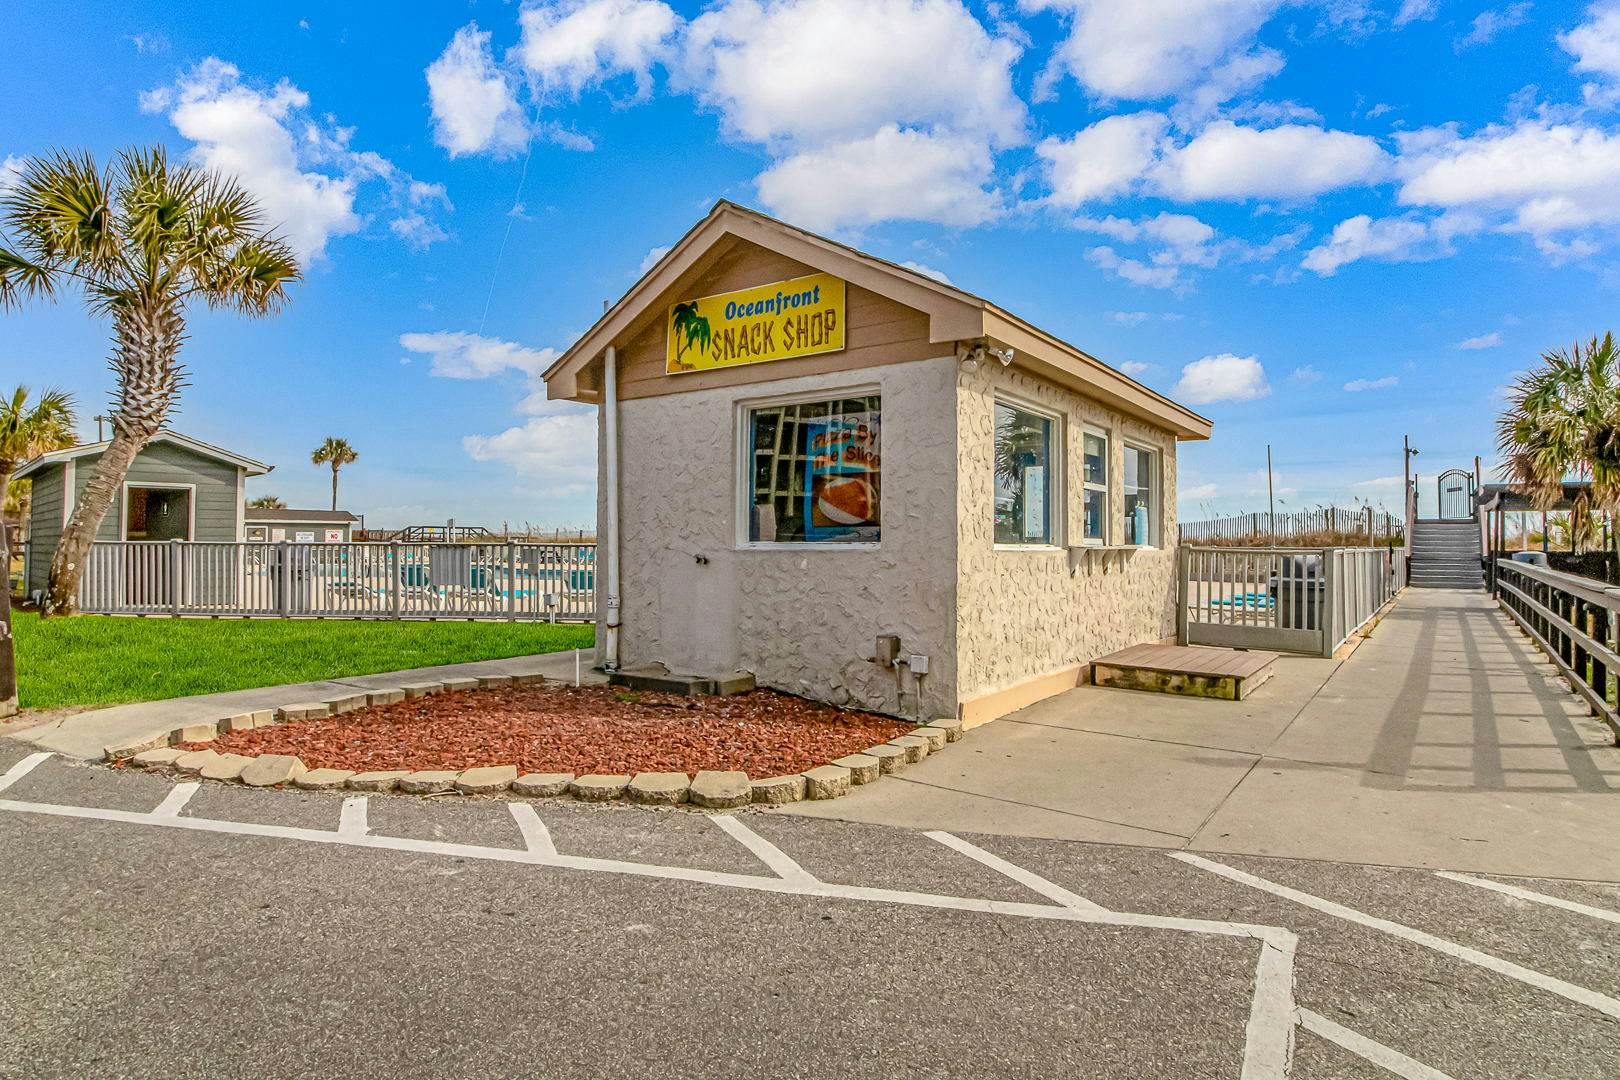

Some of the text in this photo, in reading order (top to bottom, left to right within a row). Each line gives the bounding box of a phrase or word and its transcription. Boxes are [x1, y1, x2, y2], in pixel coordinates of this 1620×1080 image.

[724, 284, 820, 321] Oceanfront
[711, 308, 837, 362] SNACK SHOP
